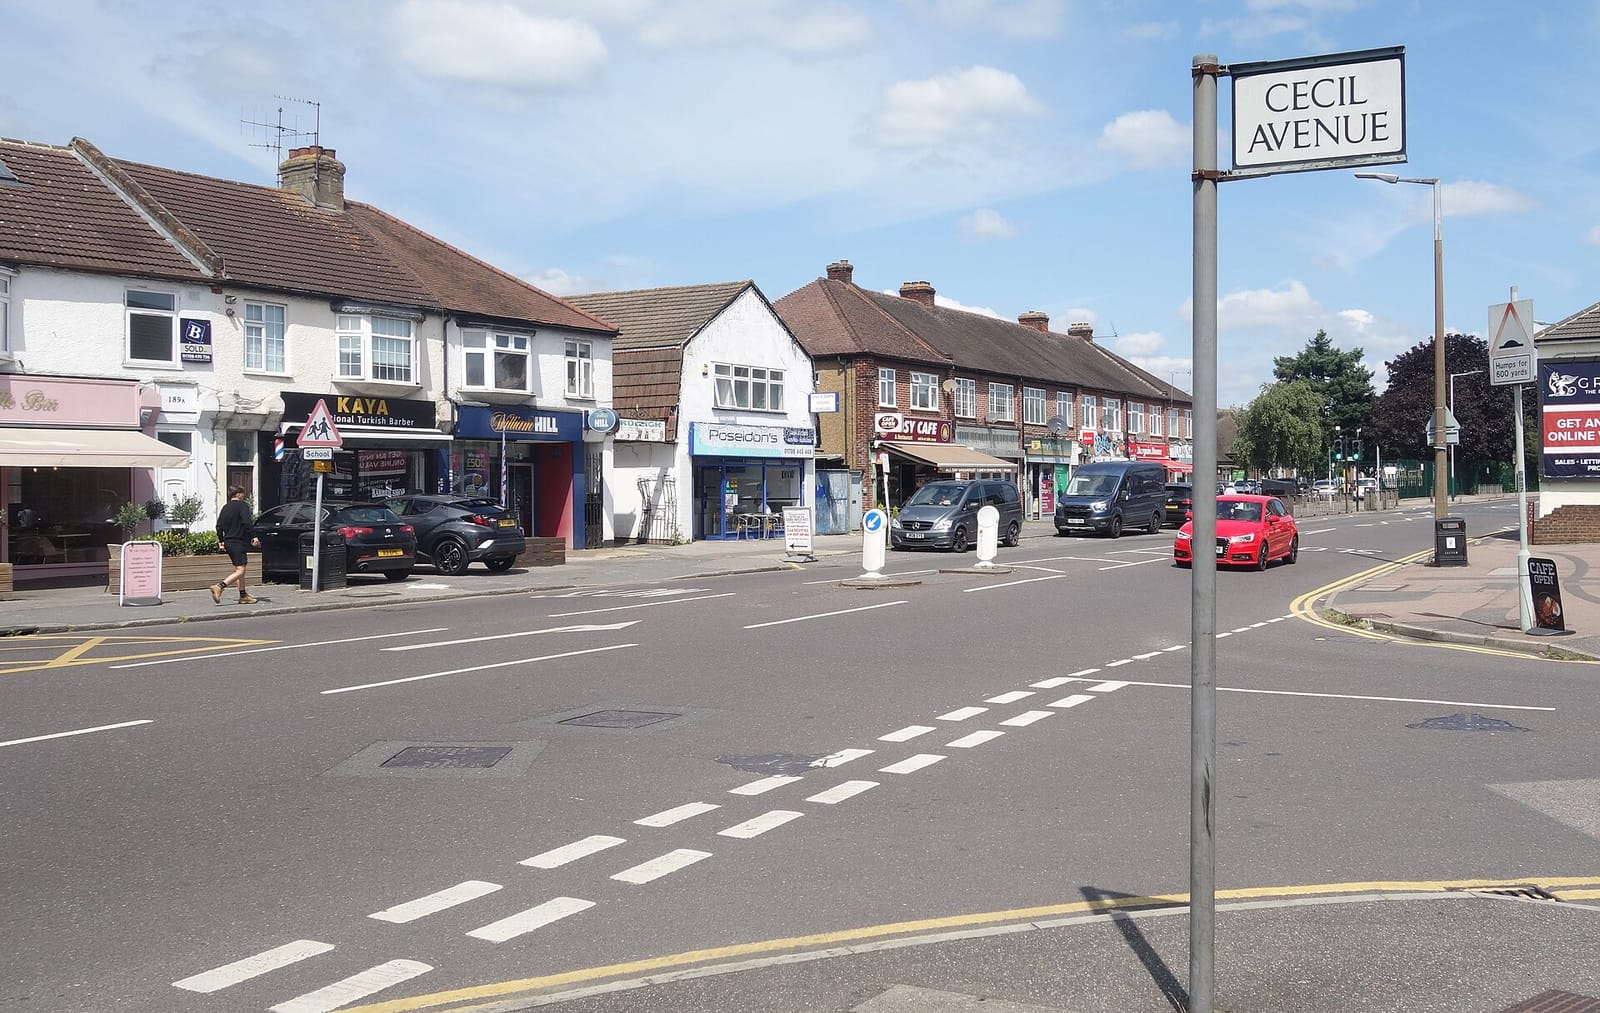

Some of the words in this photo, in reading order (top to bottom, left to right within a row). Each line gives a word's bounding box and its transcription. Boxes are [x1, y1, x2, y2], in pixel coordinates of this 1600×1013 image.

[1265, 76, 1368, 112] CECIL
[1247, 111, 1390, 153] AVENUE
[188, 325, 201, 339] B
[184, 345, 204, 353] SOLD
[1496, 361, 1516, 369] Humps
[1510, 369, 1527, 377] yards
[337, 396, 389, 415] KAYA
[357, 415, 386, 425] Turkish
[389, 417, 415, 426] Barber
[490, 411, 534, 432] William
[534, 416, 558, 432] HILL
[594, 419, 608, 427] HILL
[1557, 418, 1582, 428] GET
[903, 420, 915, 434] SY
[917, 421, 937, 435] CAFE
[709, 429, 778, 443] Poseidon's
[1548, 431, 1595, 441] ONLINE
[306, 450, 330, 458] School
[1529, 562, 1555, 576] CAFE
[1533, 574, 1554, 585] OPEN
